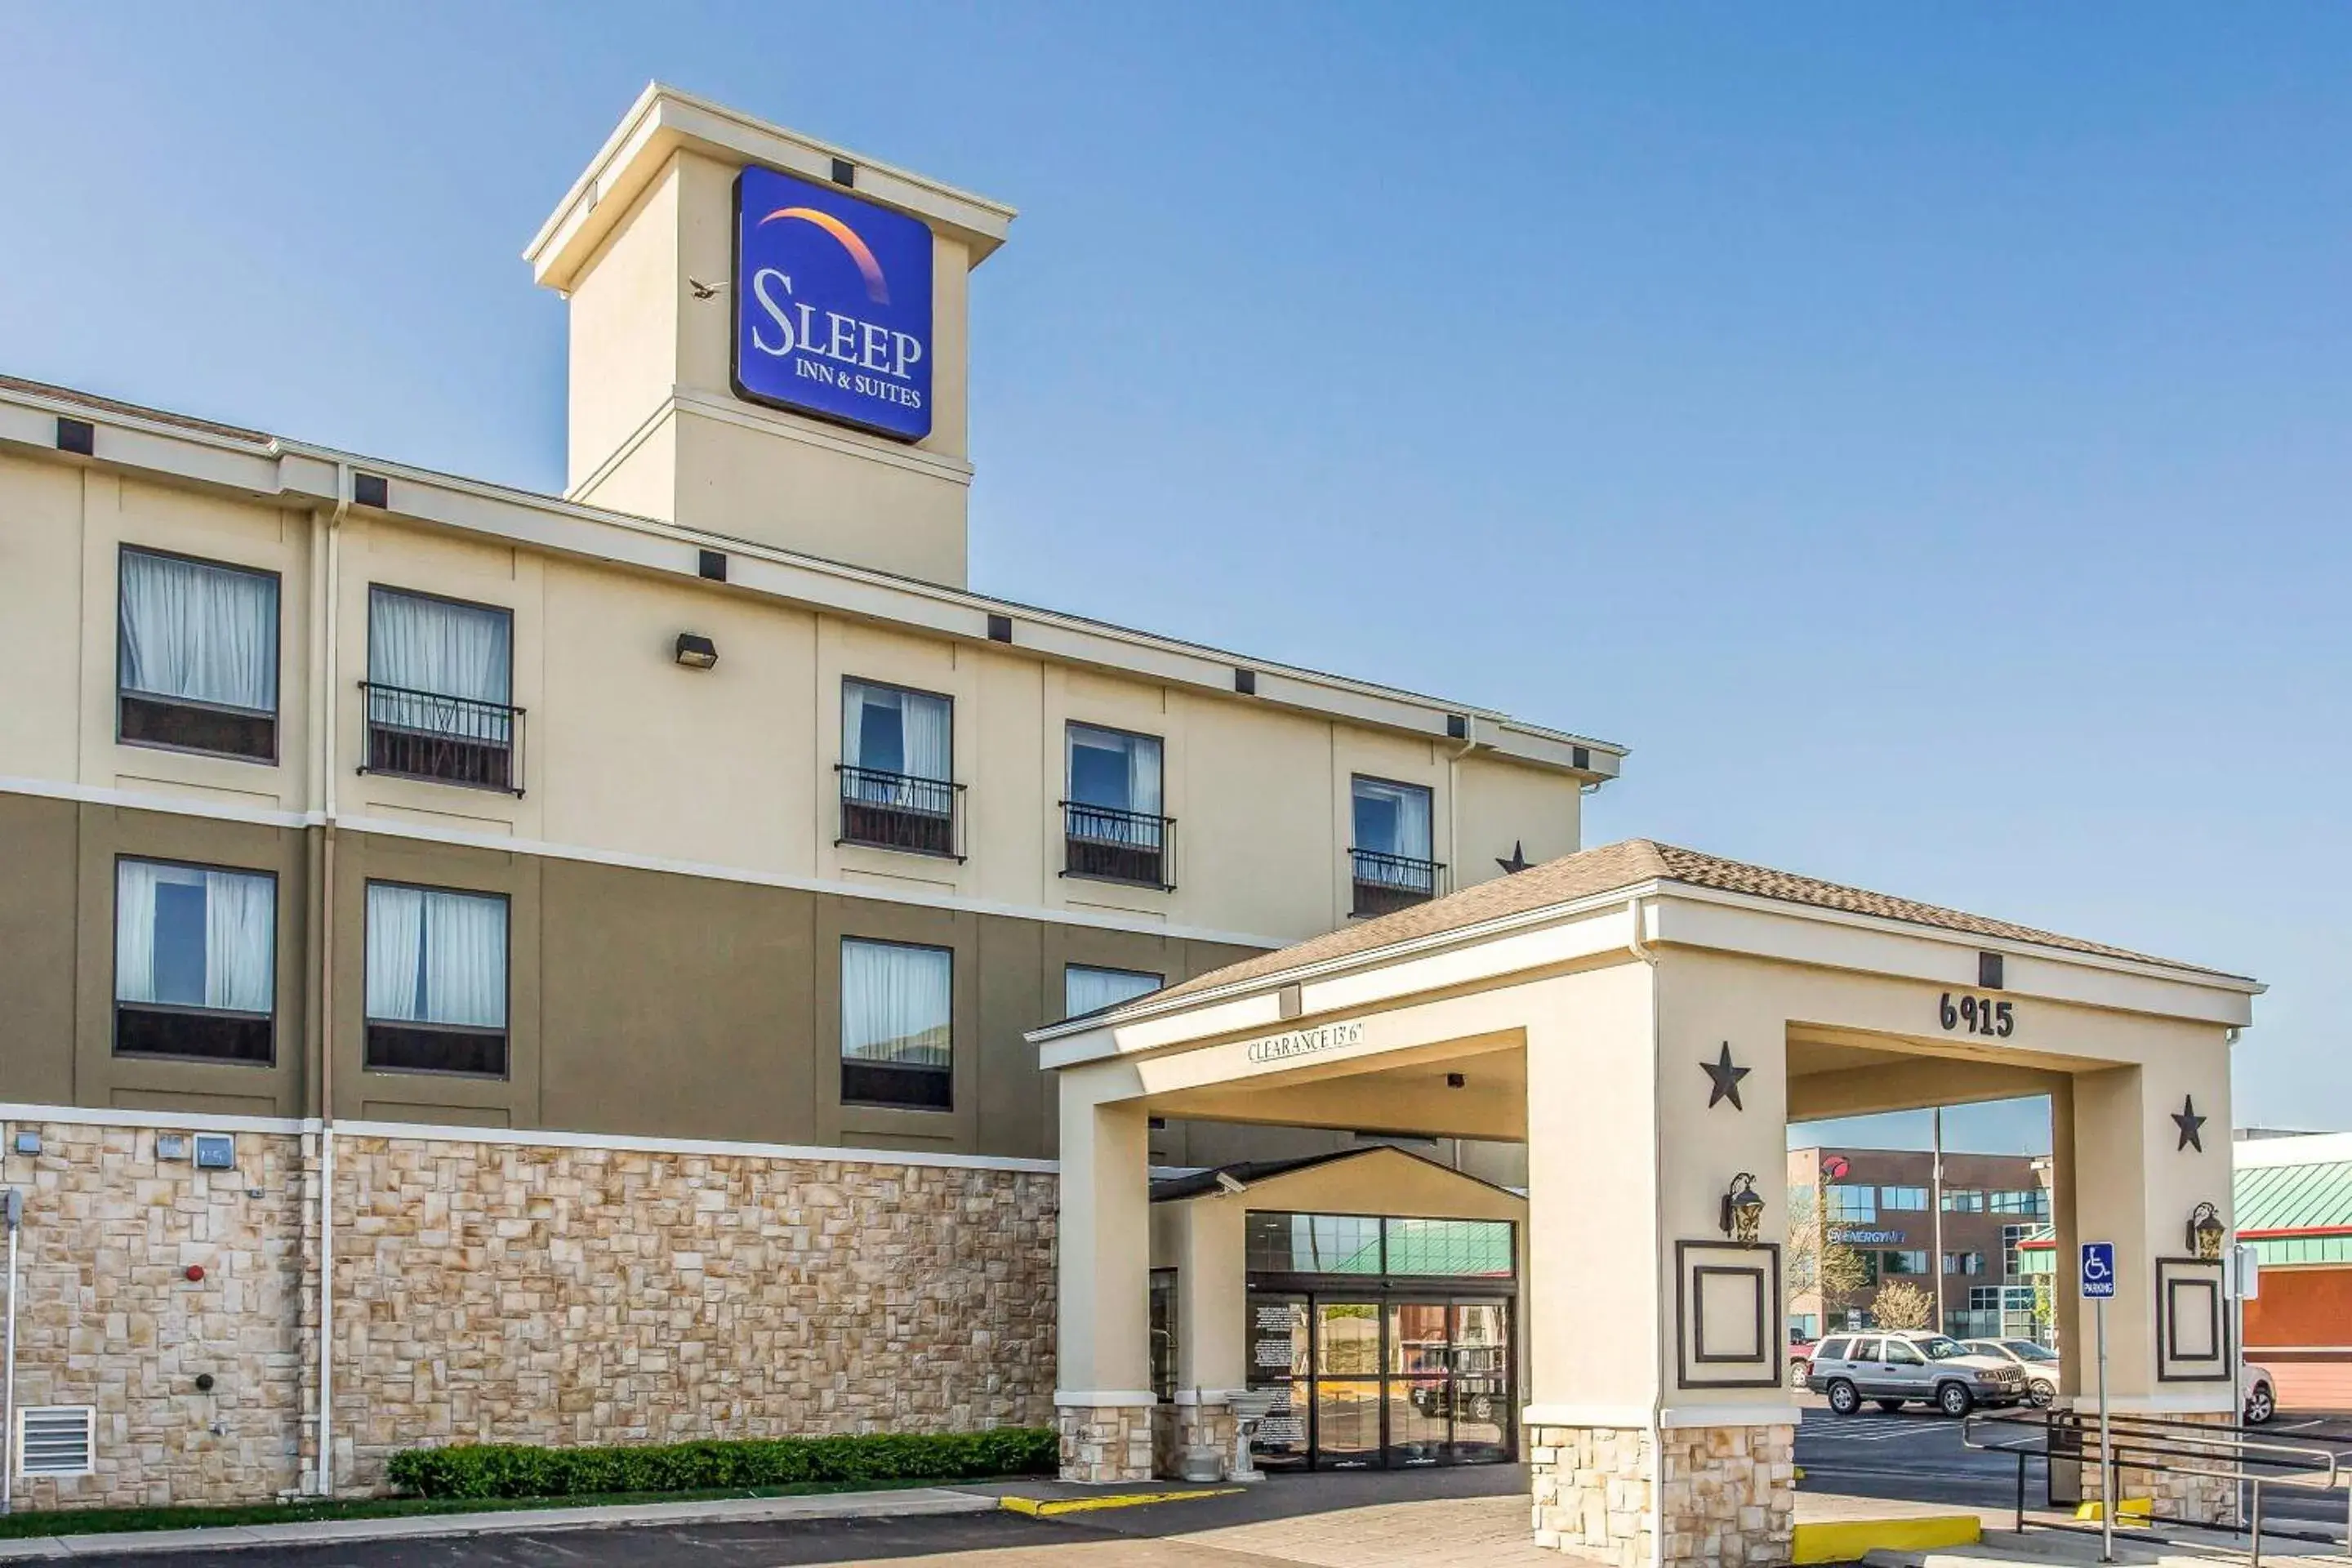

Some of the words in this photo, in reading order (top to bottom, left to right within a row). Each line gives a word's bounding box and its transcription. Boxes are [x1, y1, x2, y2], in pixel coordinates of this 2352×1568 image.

[752, 269, 921, 380] SLEEP
[795, 358, 834, 385] INN
[837, 371, 851, 390] &
[855, 375, 921, 408] SUITES
[1940, 992, 2014, 1037] 6915
[1248, 1030, 1328, 1061] CLEARANCE
[2083, 1283, 2113, 1294] PARKING
